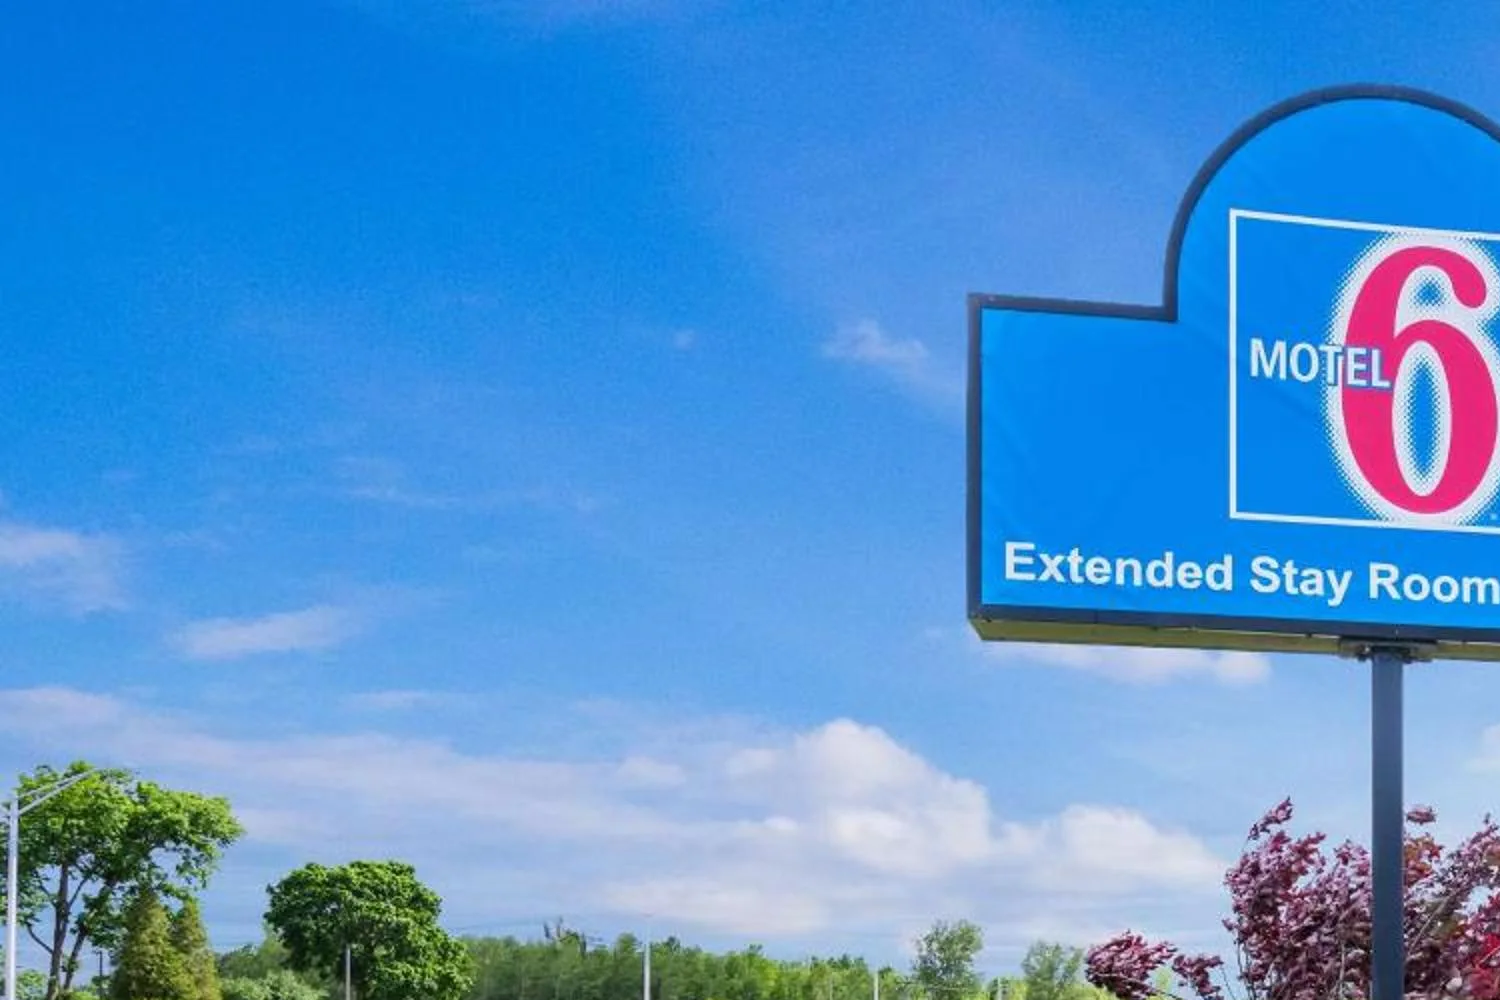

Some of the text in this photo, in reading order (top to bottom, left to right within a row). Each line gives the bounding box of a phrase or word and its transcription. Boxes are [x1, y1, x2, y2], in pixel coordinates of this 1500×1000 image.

[1250, 245, 1499, 515] MOTEL 6
[1004, 540, 1234, 592] Extended
[1249, 555, 1353, 607] Stay
